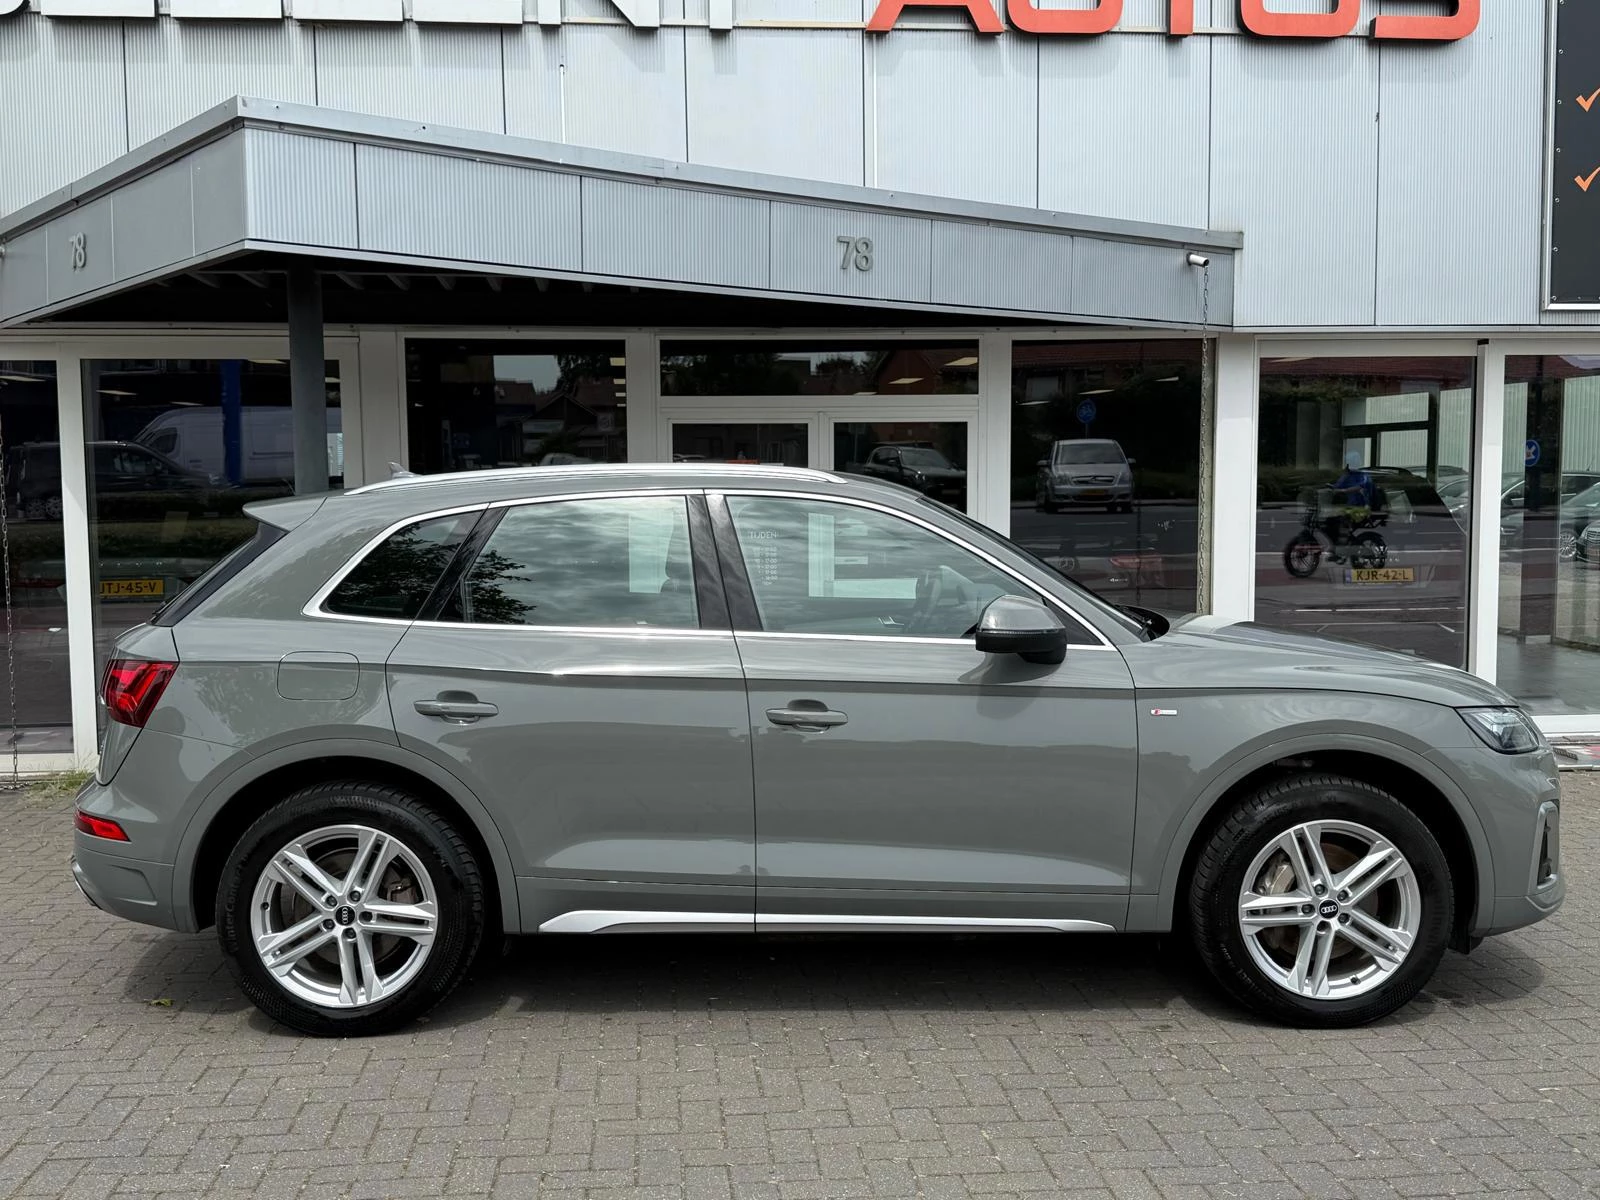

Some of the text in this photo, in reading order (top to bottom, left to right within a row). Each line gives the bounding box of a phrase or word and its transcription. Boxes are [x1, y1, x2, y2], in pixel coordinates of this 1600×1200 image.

[69, 232, 87, 270] 78
[837, 236, 873, 271] 78
[1356, 570, 1409, 580] KJR-42-L
[100, 582, 156, 593] JTJ-45-V
